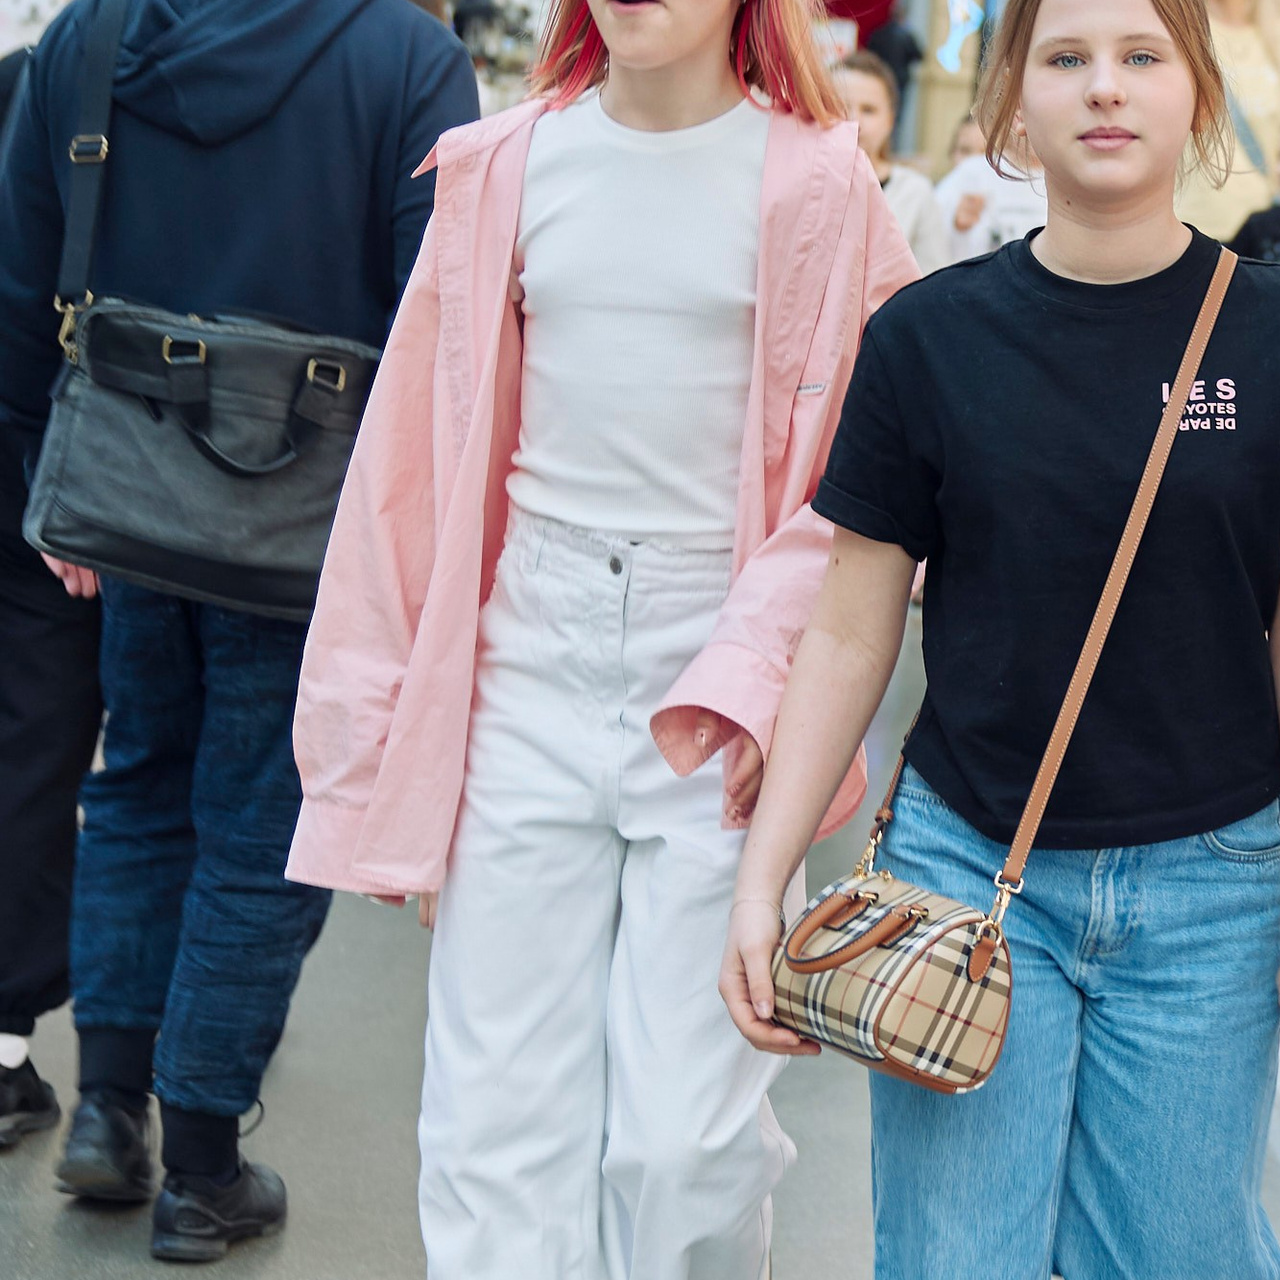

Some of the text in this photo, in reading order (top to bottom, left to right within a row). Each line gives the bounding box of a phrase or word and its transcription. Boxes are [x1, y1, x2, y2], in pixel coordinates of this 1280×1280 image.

[1162, 402, 1237, 415] YOTES
[1179, 417, 1236, 431] DE PAR
